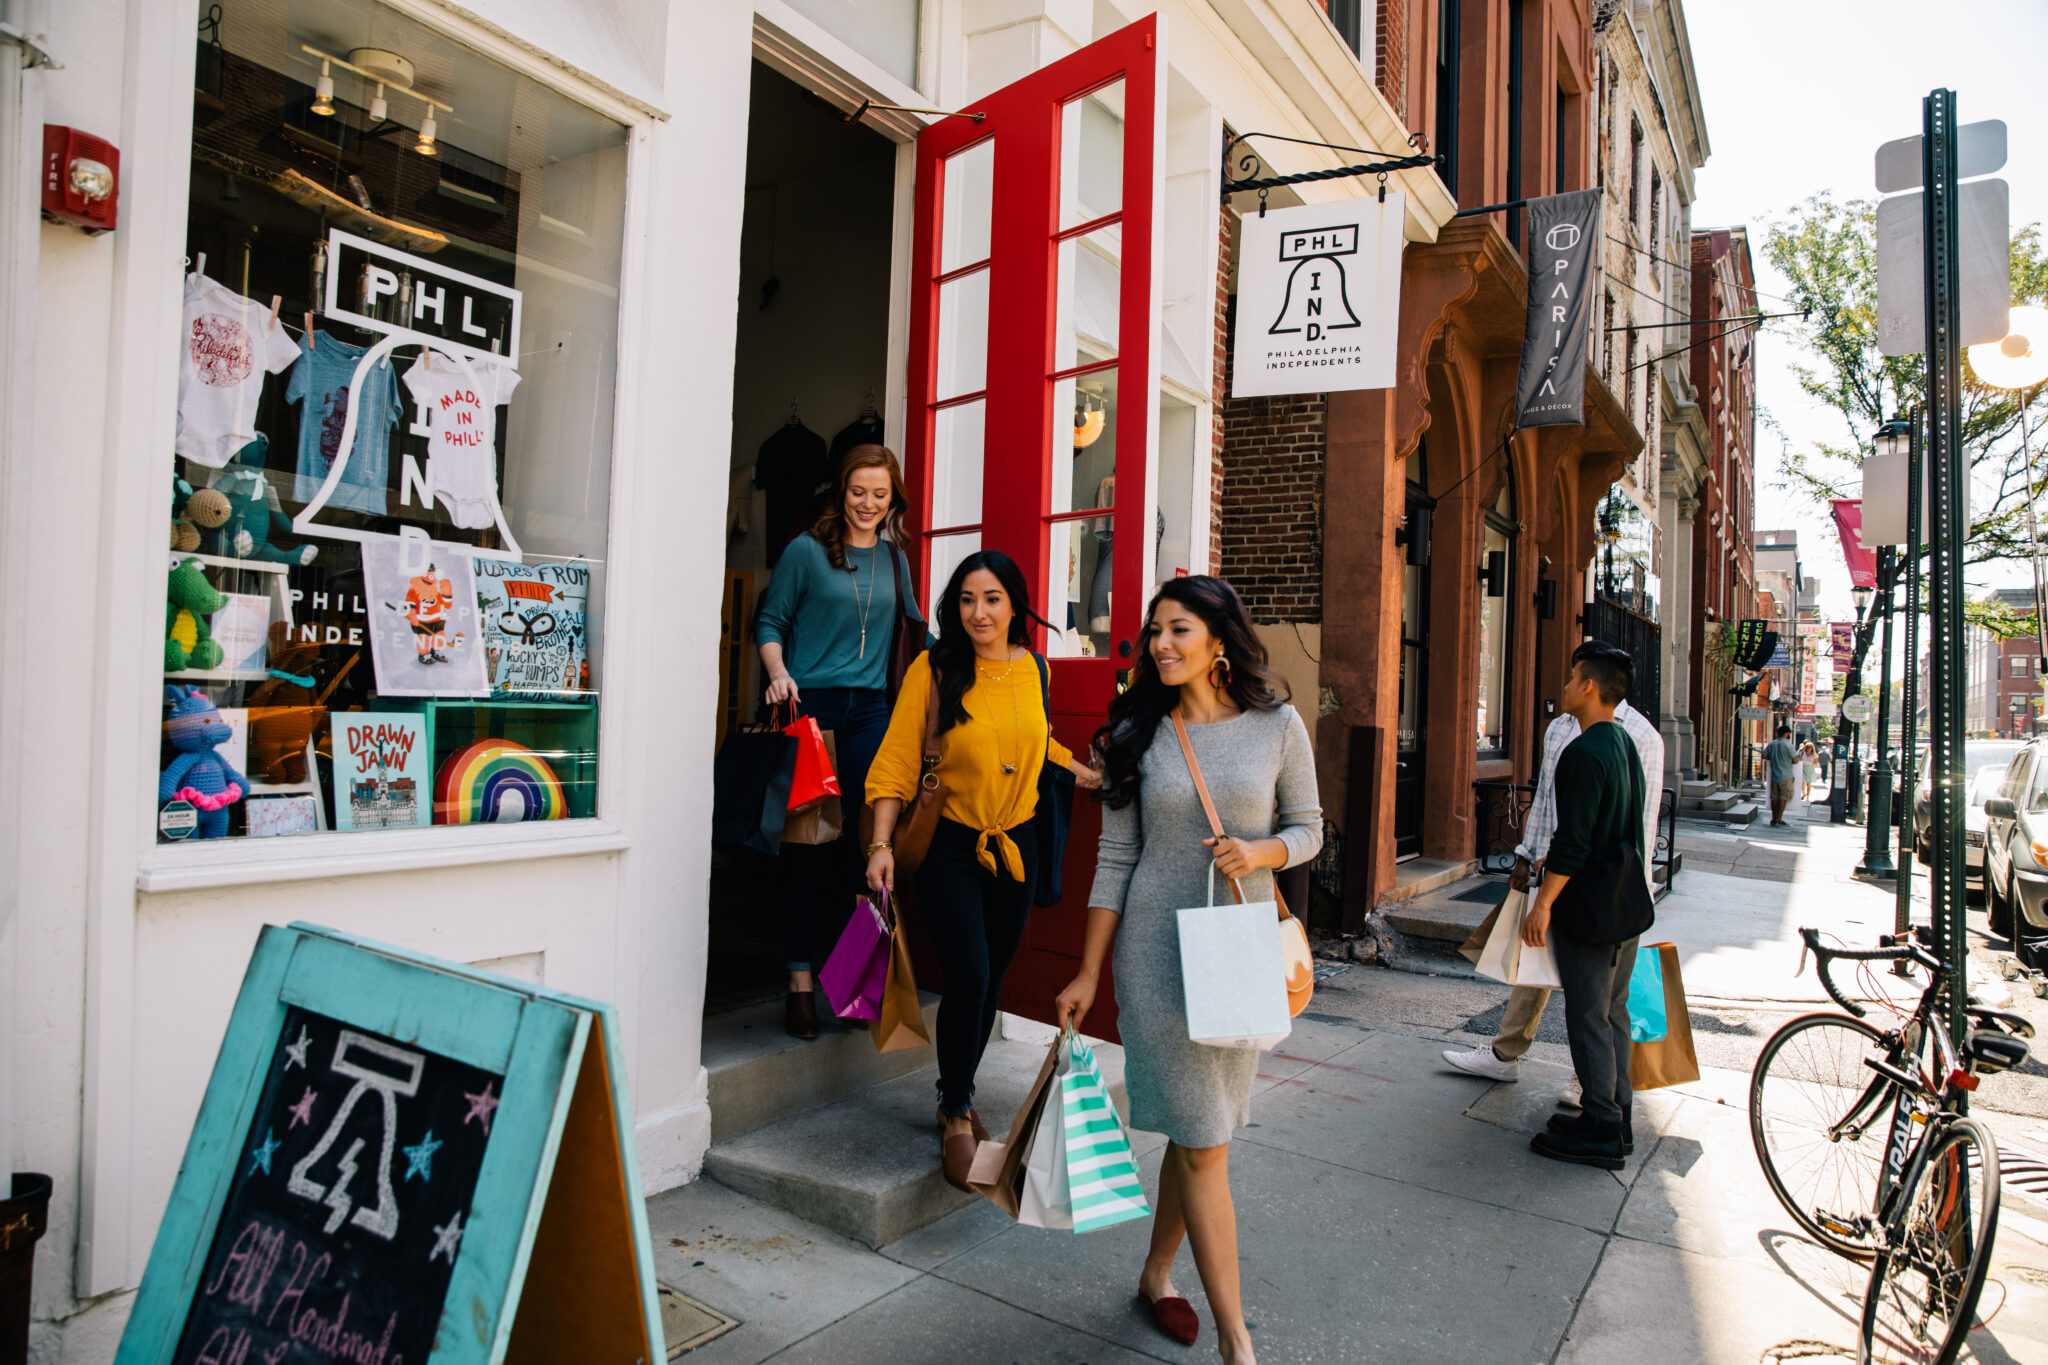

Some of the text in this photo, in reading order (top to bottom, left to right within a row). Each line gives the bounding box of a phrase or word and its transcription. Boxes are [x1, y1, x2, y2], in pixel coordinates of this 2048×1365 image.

[49, 152, 59, 191] FIRE
[1294, 234, 1343, 252] PHL
[366, 264, 487, 338] PHL
[1267, 345, 1361, 359] PHILADELPHIA
[1266, 356, 1361, 371] INDEPENDENTS
[457, 411, 473, 425] IN
[538, 566, 590, 586] FROM
[525, 664, 560, 683] BUMPS
[347, 723, 416, 755] DRAWN
[355, 746, 408, 774] JAWN
[206, 1220, 285, 1317] All
